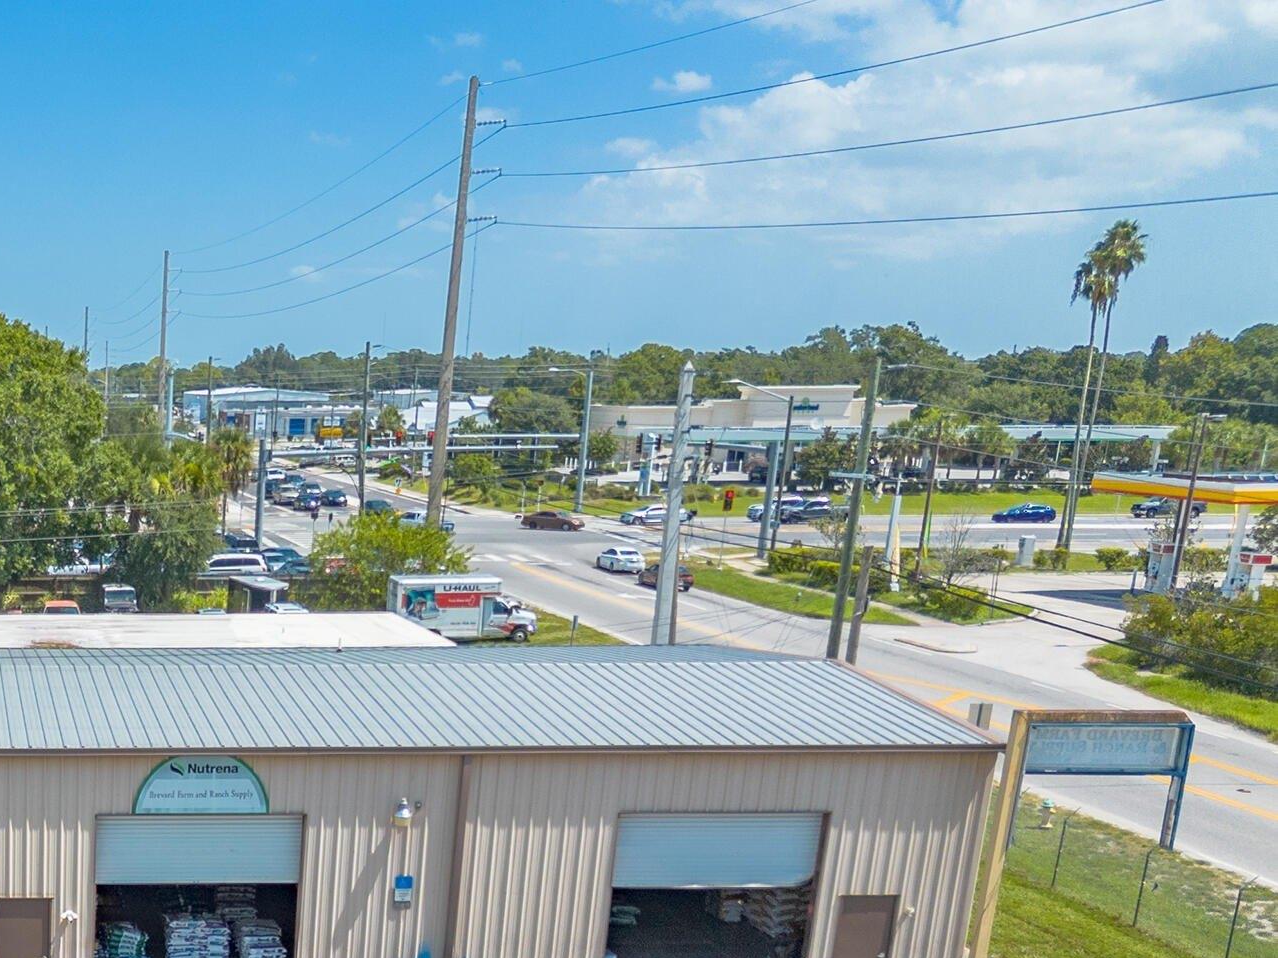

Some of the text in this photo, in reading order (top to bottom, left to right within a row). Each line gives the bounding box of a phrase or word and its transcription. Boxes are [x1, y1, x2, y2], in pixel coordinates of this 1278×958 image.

[187, 763, 239, 774] Nutrena
[149, 789, 254, 800] Brevard Farm and Ranch Supply
